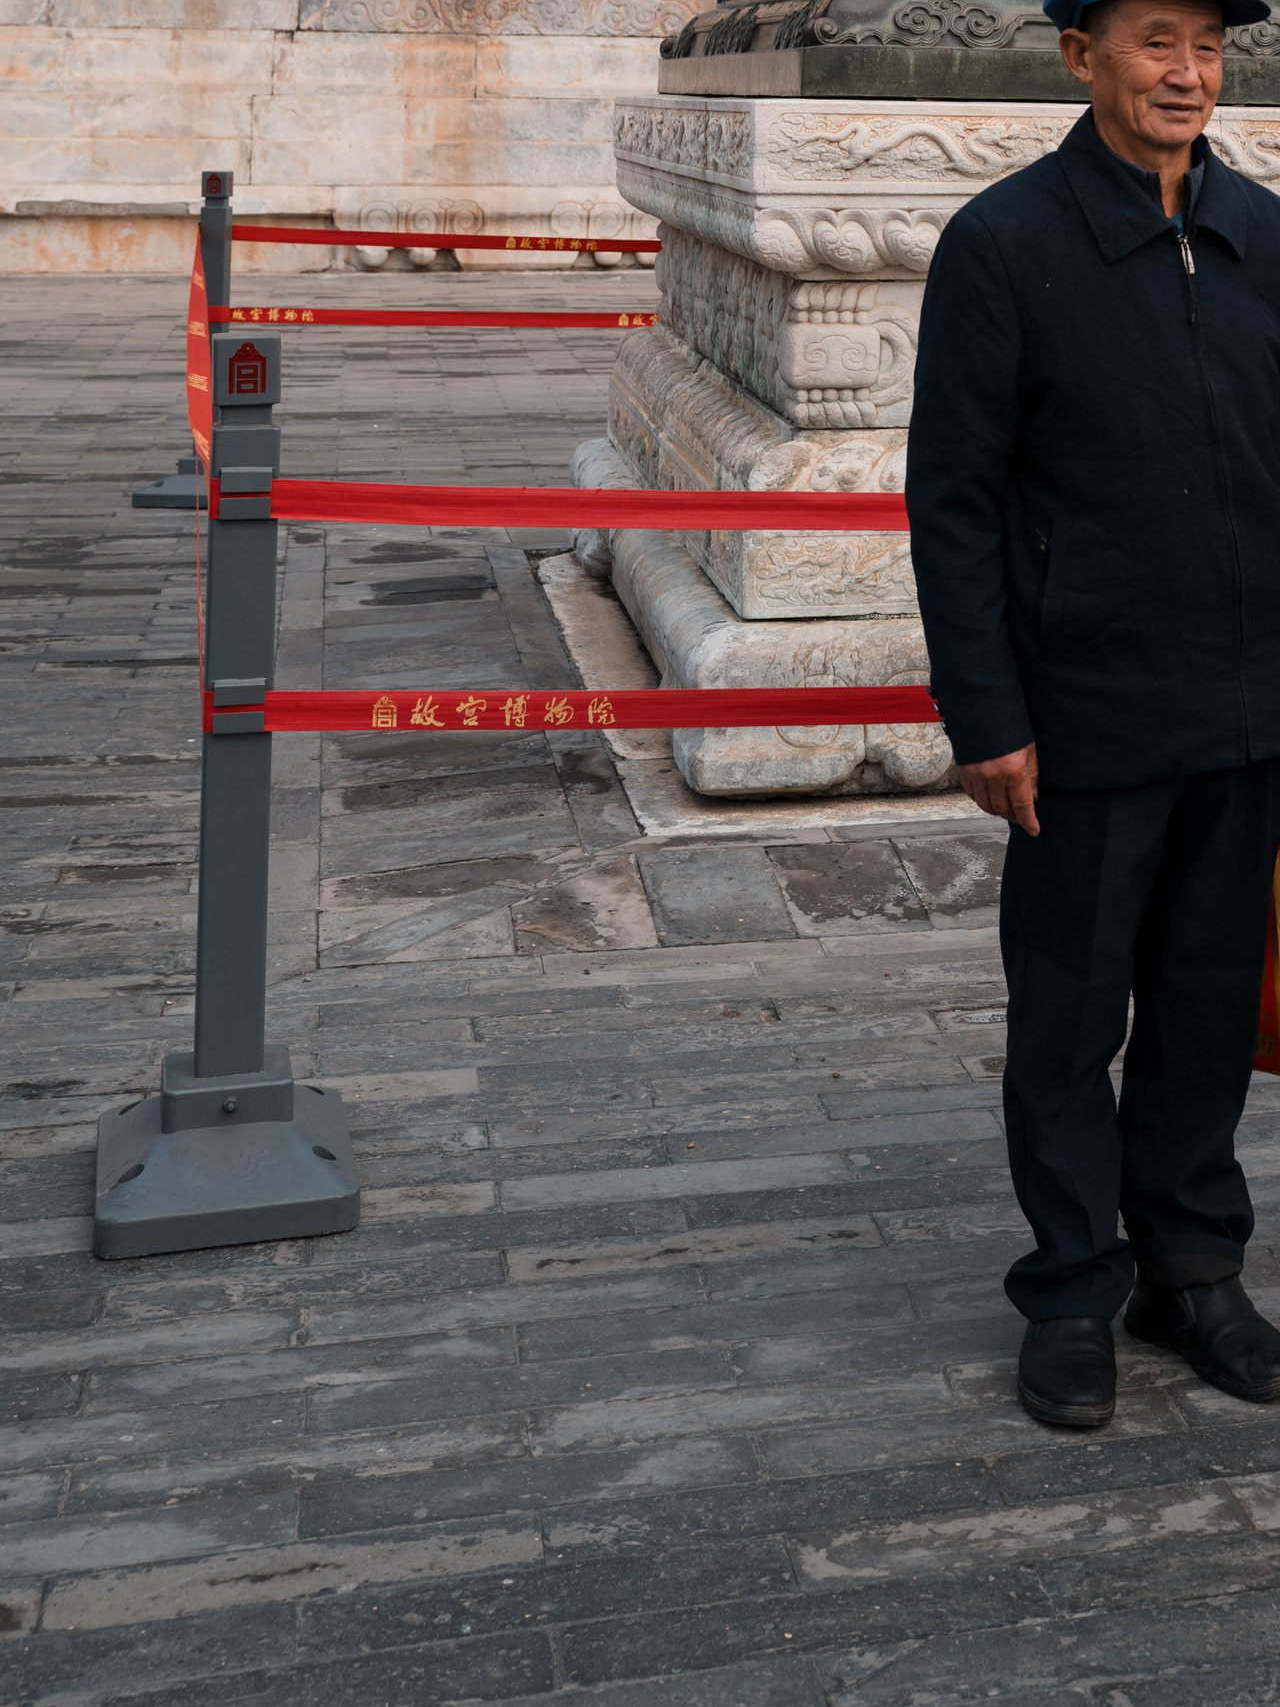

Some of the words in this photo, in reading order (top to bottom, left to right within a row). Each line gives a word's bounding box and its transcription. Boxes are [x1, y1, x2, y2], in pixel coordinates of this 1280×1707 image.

[520, 237, 598, 251] 故宫博物院
[232, 308, 314, 322] 故宫博物院
[409, 695, 617, 727] 故宫博物院
